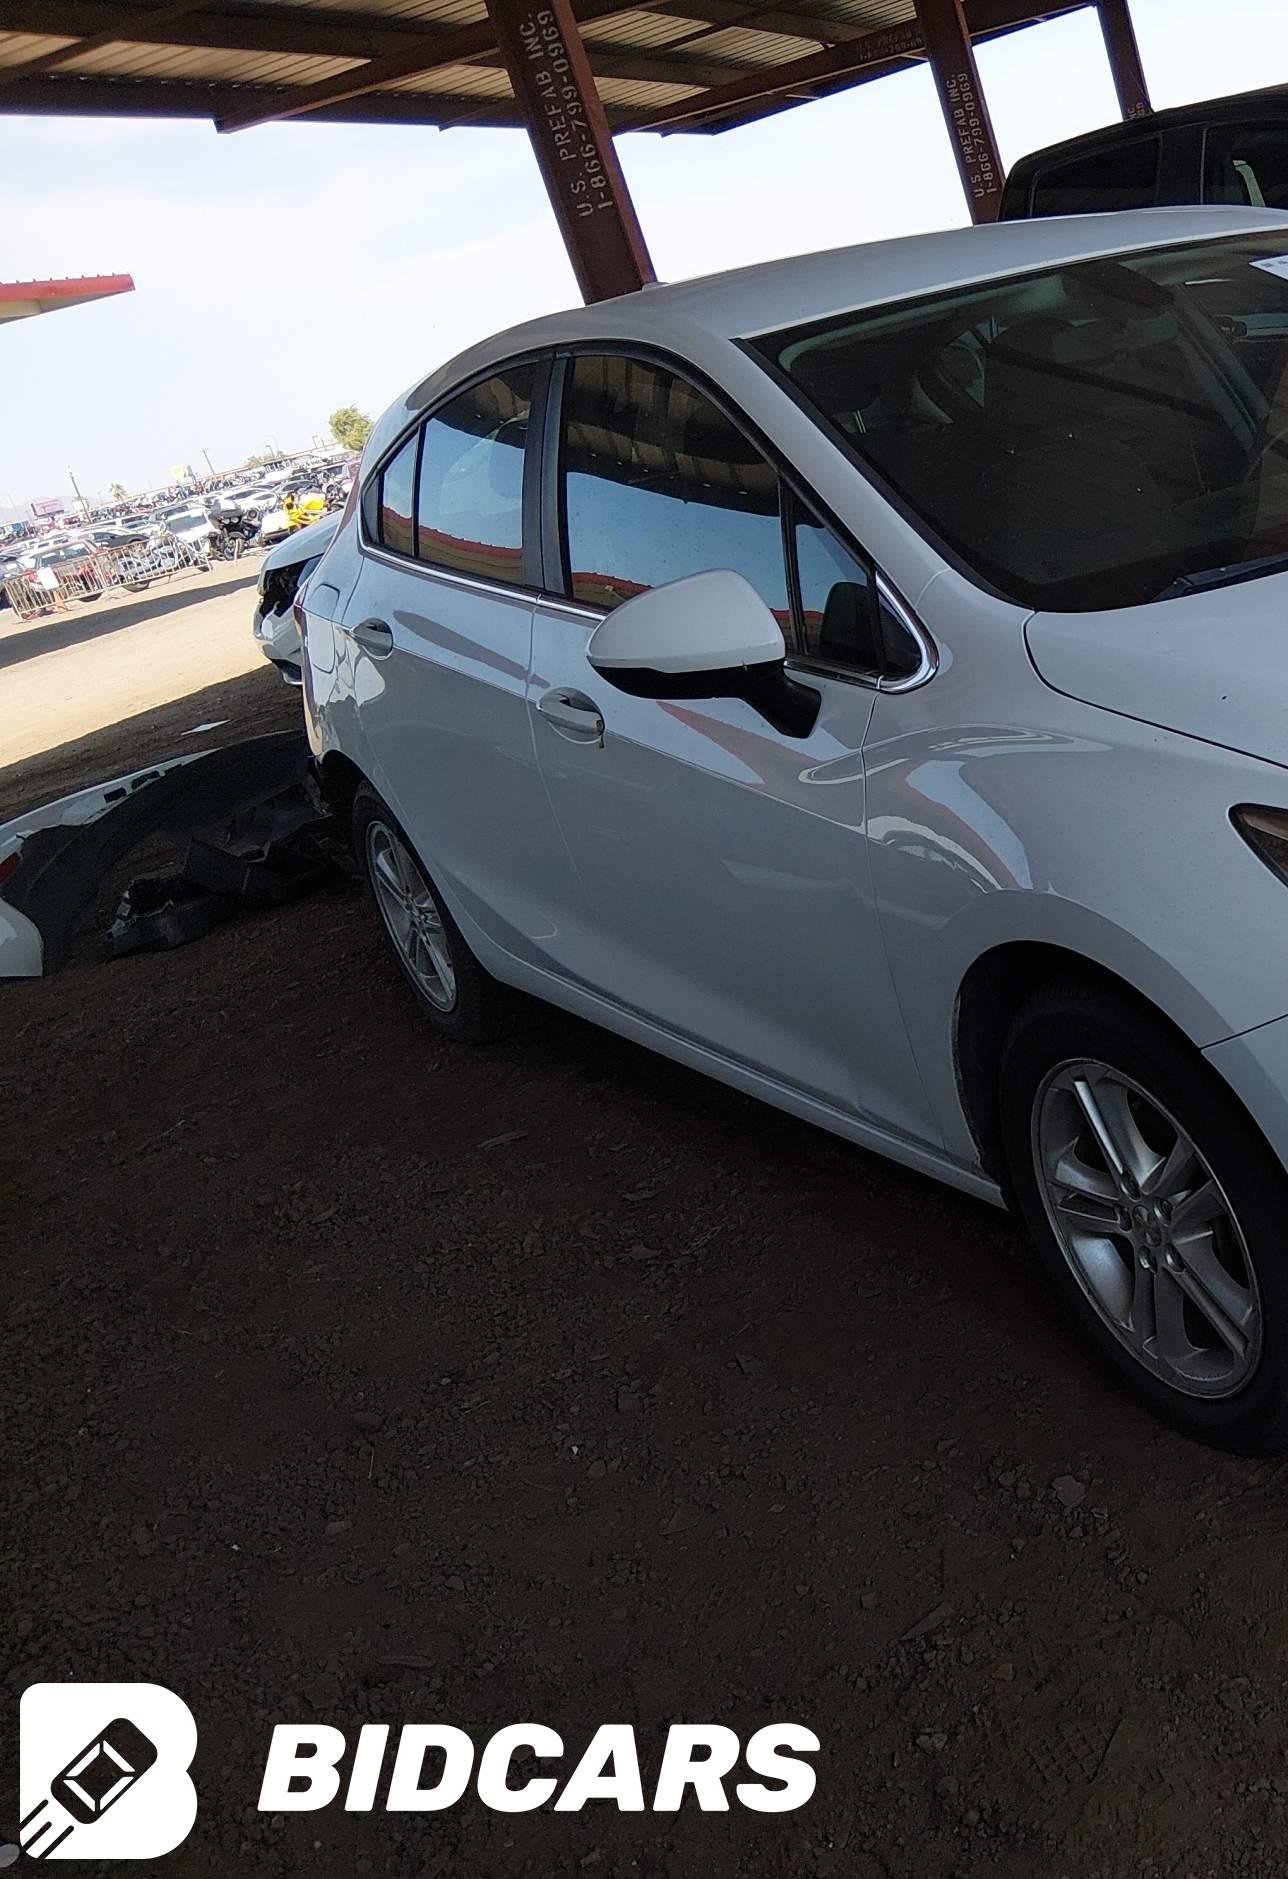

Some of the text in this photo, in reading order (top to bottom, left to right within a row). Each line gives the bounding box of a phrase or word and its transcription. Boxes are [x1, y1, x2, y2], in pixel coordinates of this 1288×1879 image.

[520, 14, 593, 216] U.S. PREFAB INC.
[537, 10, 613, 209] 1-866-799-0969
[947, 74, 984, 197] U.S. PREFAB INC.
[958, 73, 997, 193] 1-866-799-0969
